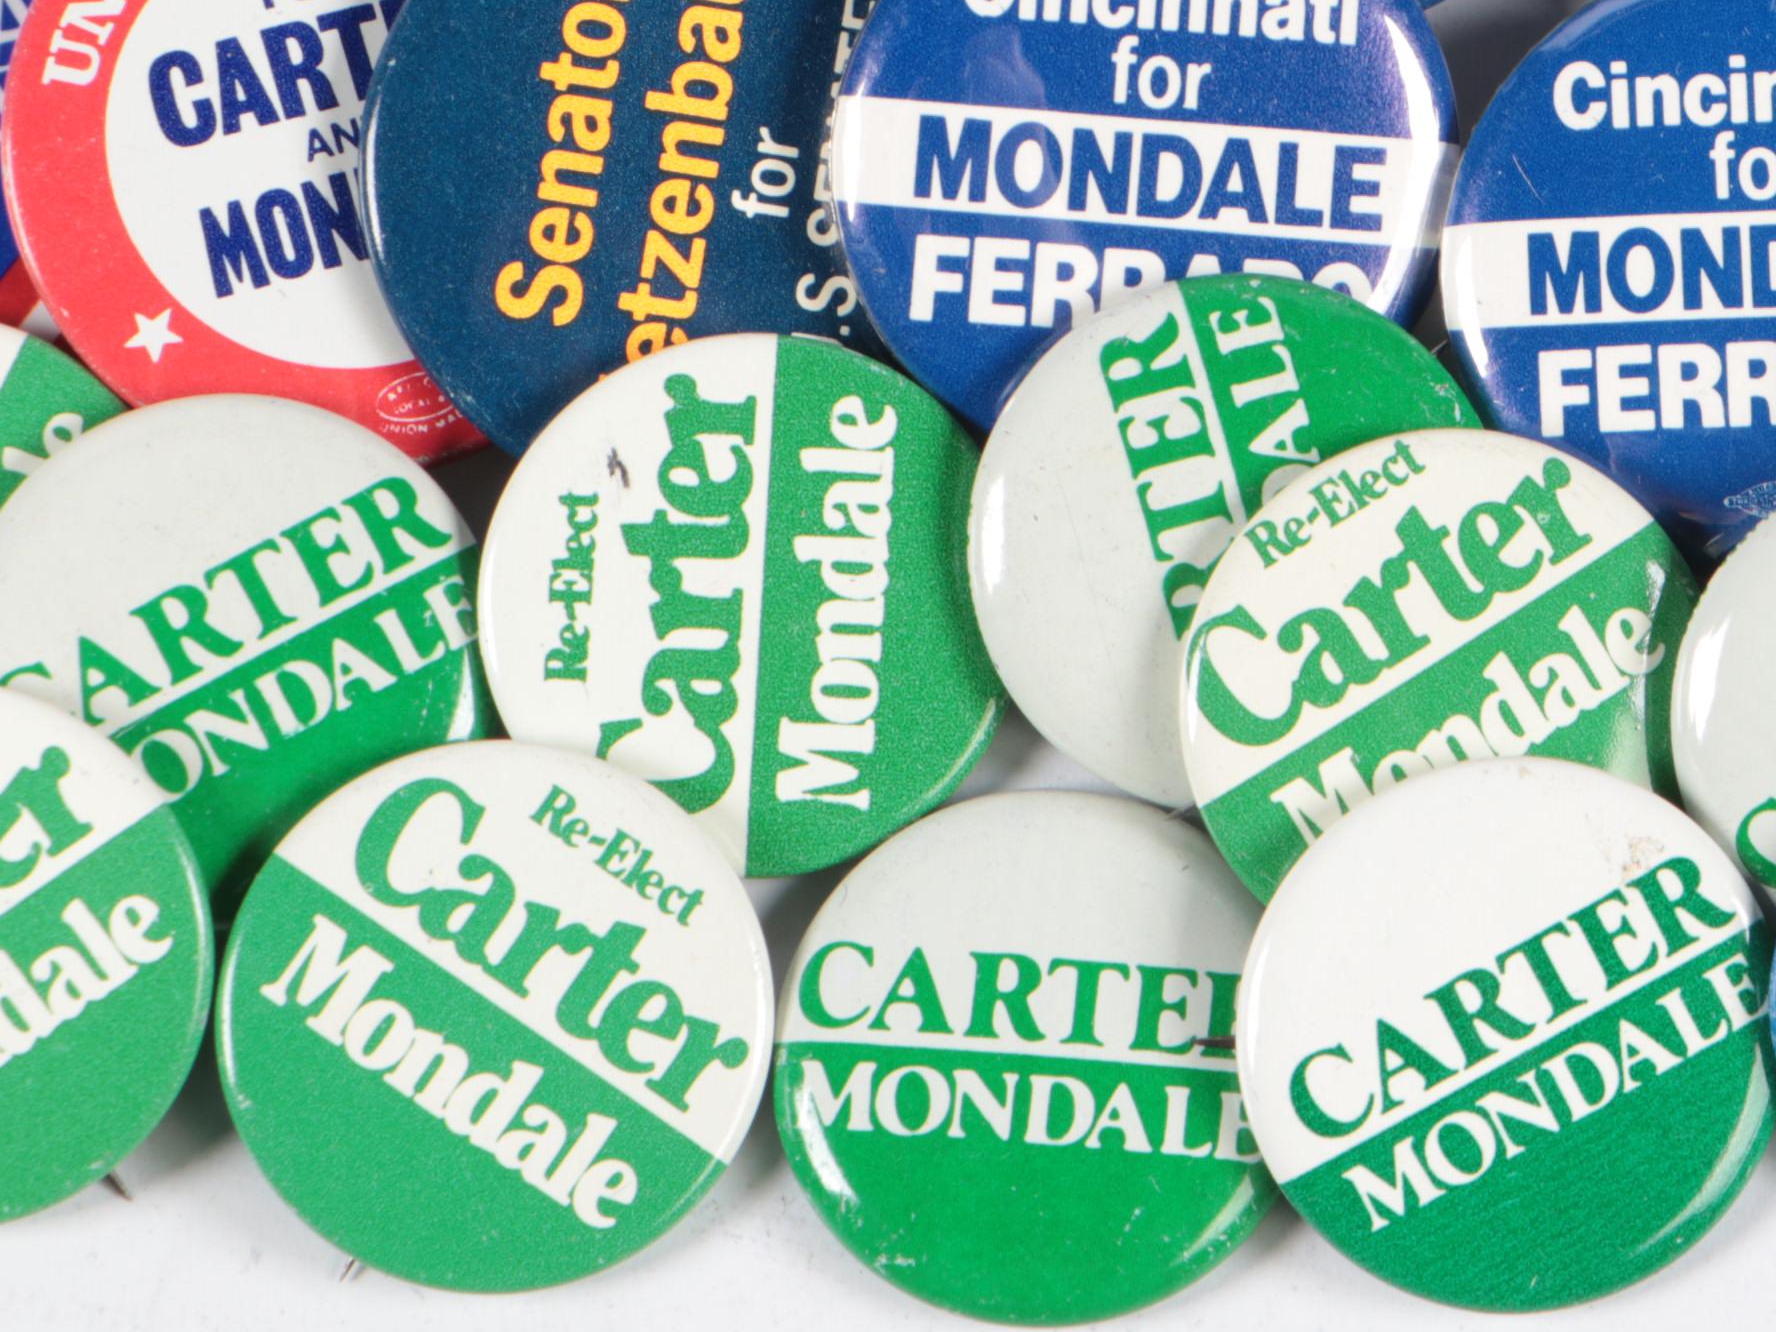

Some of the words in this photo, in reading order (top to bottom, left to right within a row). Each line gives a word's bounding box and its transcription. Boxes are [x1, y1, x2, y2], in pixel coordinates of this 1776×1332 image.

[307, 118, 361, 162] AN
[731, 127, 799, 218] for
[914, 114, 1388, 232] MONDALE
[1111, 35, 1211, 110] for
[0, 476, 453, 727] ARTER
[543, 492, 600, 684] Re-Elect
[599, 373, 758, 816] Carter
[775, 395, 898, 811] Mondale
[1189, 457, 1593, 747] Carter
[1244, 440, 1426, 568] Re-Elect
[131, 574, 480, 799] ONDALE
[354, 777, 749, 1113] Carter
[530, 784, 706, 926] Re-Elect
[260, 914, 638, 1228] Mondale
[1289, 855, 1736, 1138] CARTER
[1342, 953, 1770, 1233] MONDALE
[802, 1060, 1264, 1164] MONDALE
